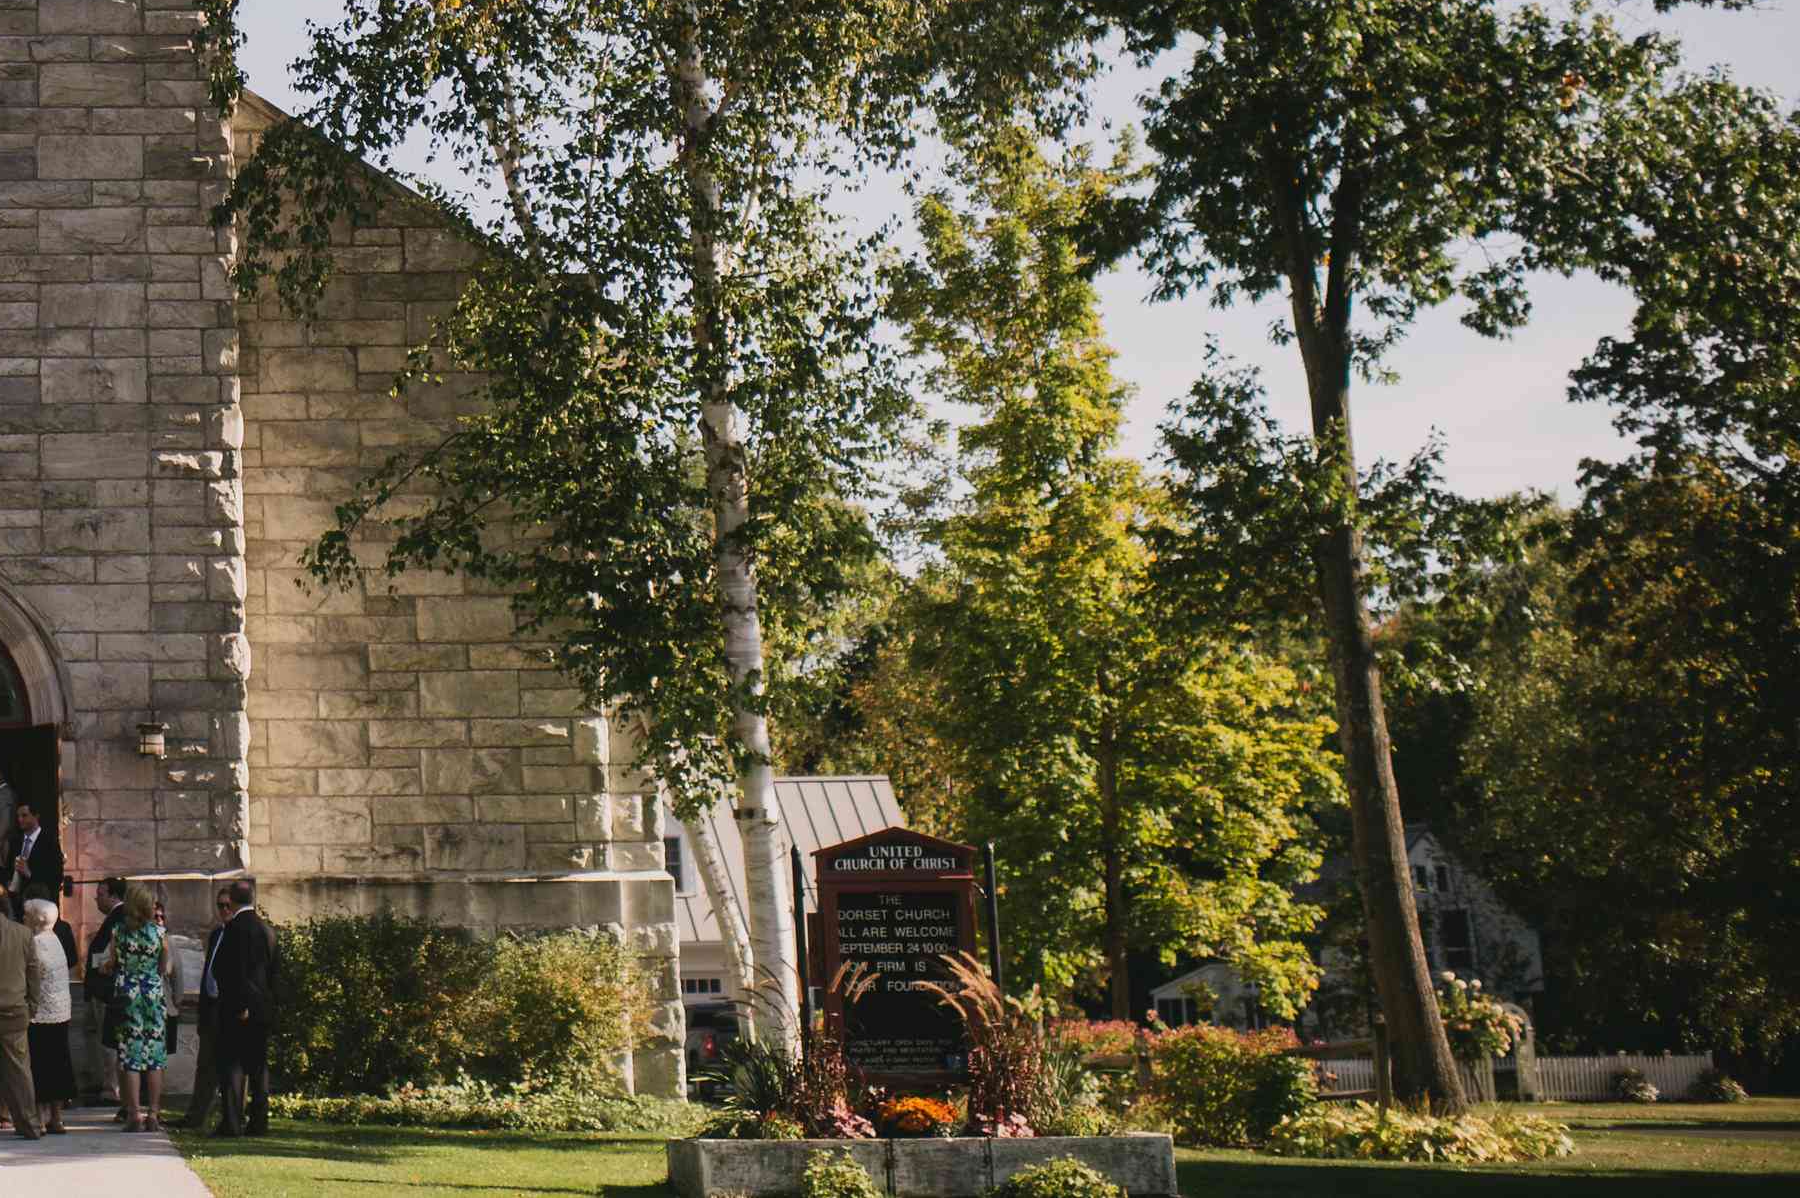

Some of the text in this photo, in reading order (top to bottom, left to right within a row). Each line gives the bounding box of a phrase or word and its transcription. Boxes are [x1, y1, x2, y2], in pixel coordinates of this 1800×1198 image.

[869, 846, 922, 858] UNITED
[834, 858, 956, 871] CHURCH OF CHRIST
[879, 895, 903, 906] THE
[837, 908, 950, 921] DORSET CHURCH
[861, 926, 888, 938] ARE
[894, 926, 958, 938] WELCOME
[907, 942, 920, 954] 24
[876, 961, 906, 972] FIRM
[914, 961, 927, 972] IS
[844, 980, 876, 992] YOR
